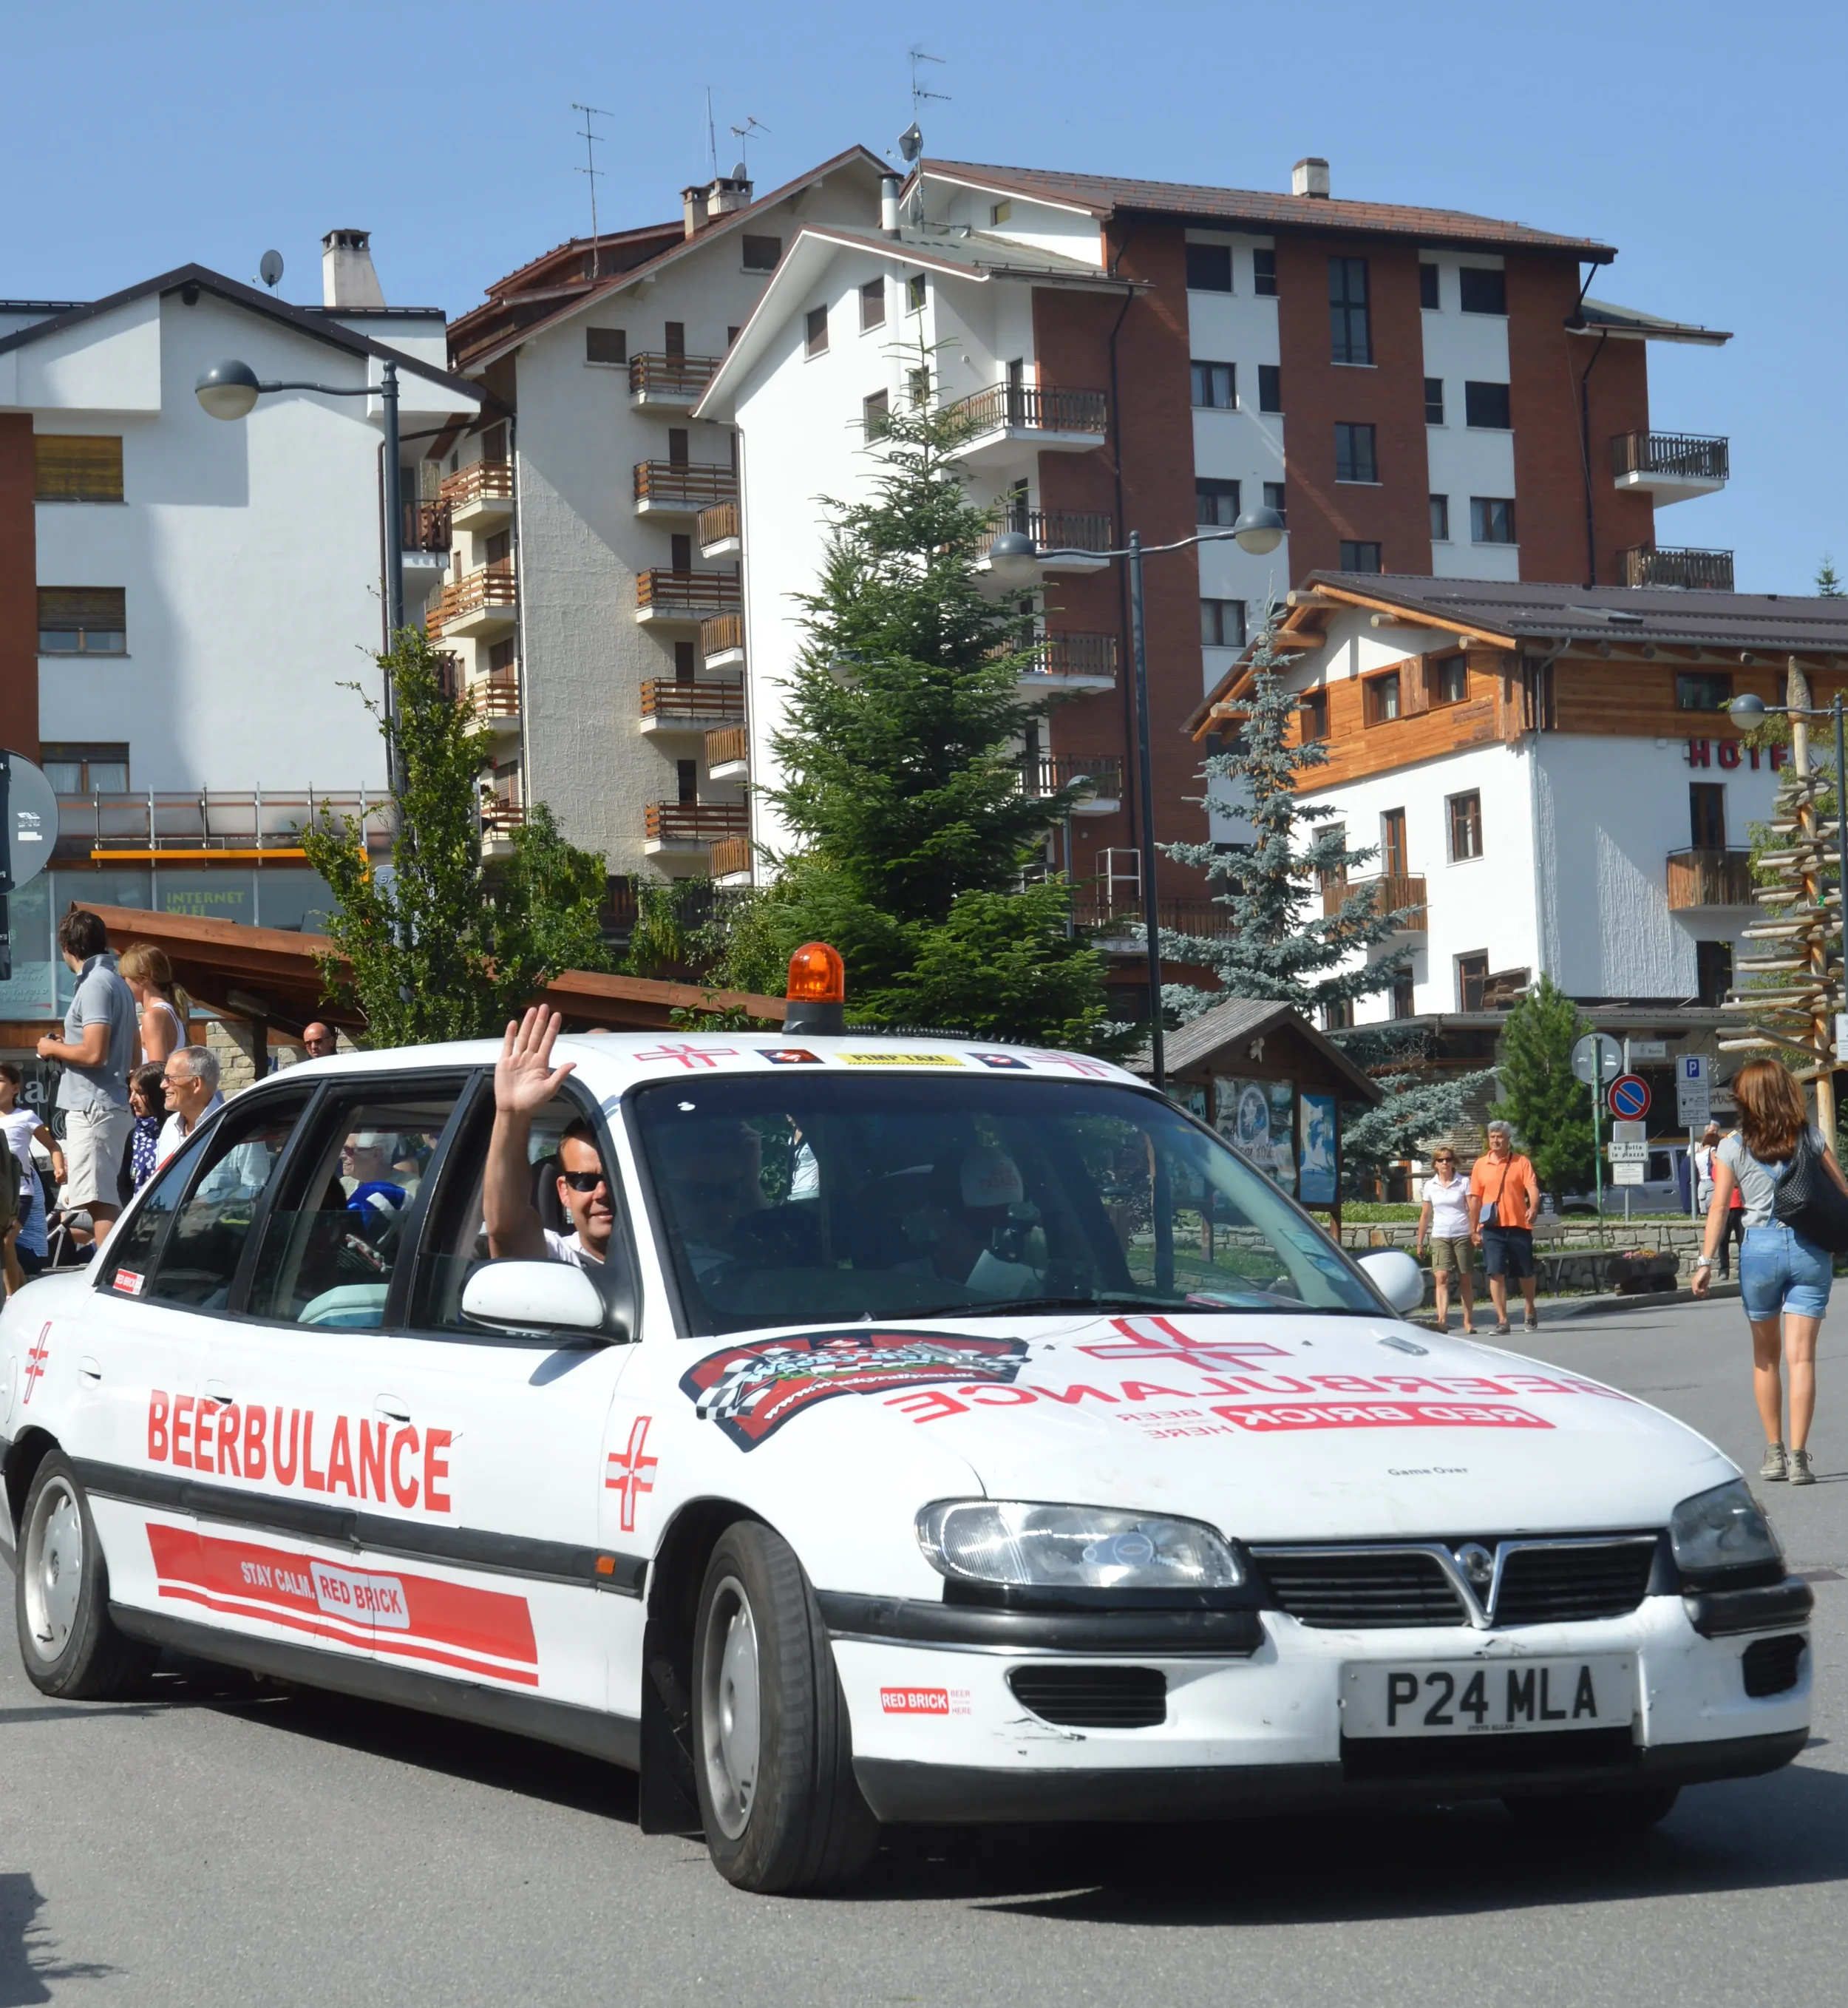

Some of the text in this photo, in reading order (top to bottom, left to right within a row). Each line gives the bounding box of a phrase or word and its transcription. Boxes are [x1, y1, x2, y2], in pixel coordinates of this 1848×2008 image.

[1690, 739, 1788, 771] HOTE
[166, 891, 245, 903] INTERNET
[851, 1054, 905, 1062] PIMP
[147, 1389, 452, 1513] BEERBULANCE
[241, 1561, 316, 1600] STAY CALM.
[319, 1574, 403, 1614] RED BRICK
[882, 1692, 948, 1709] RED BRICK
[951, 1689, 971, 1697] BEER
[1387, 1665, 1598, 1727] P24 MLA
